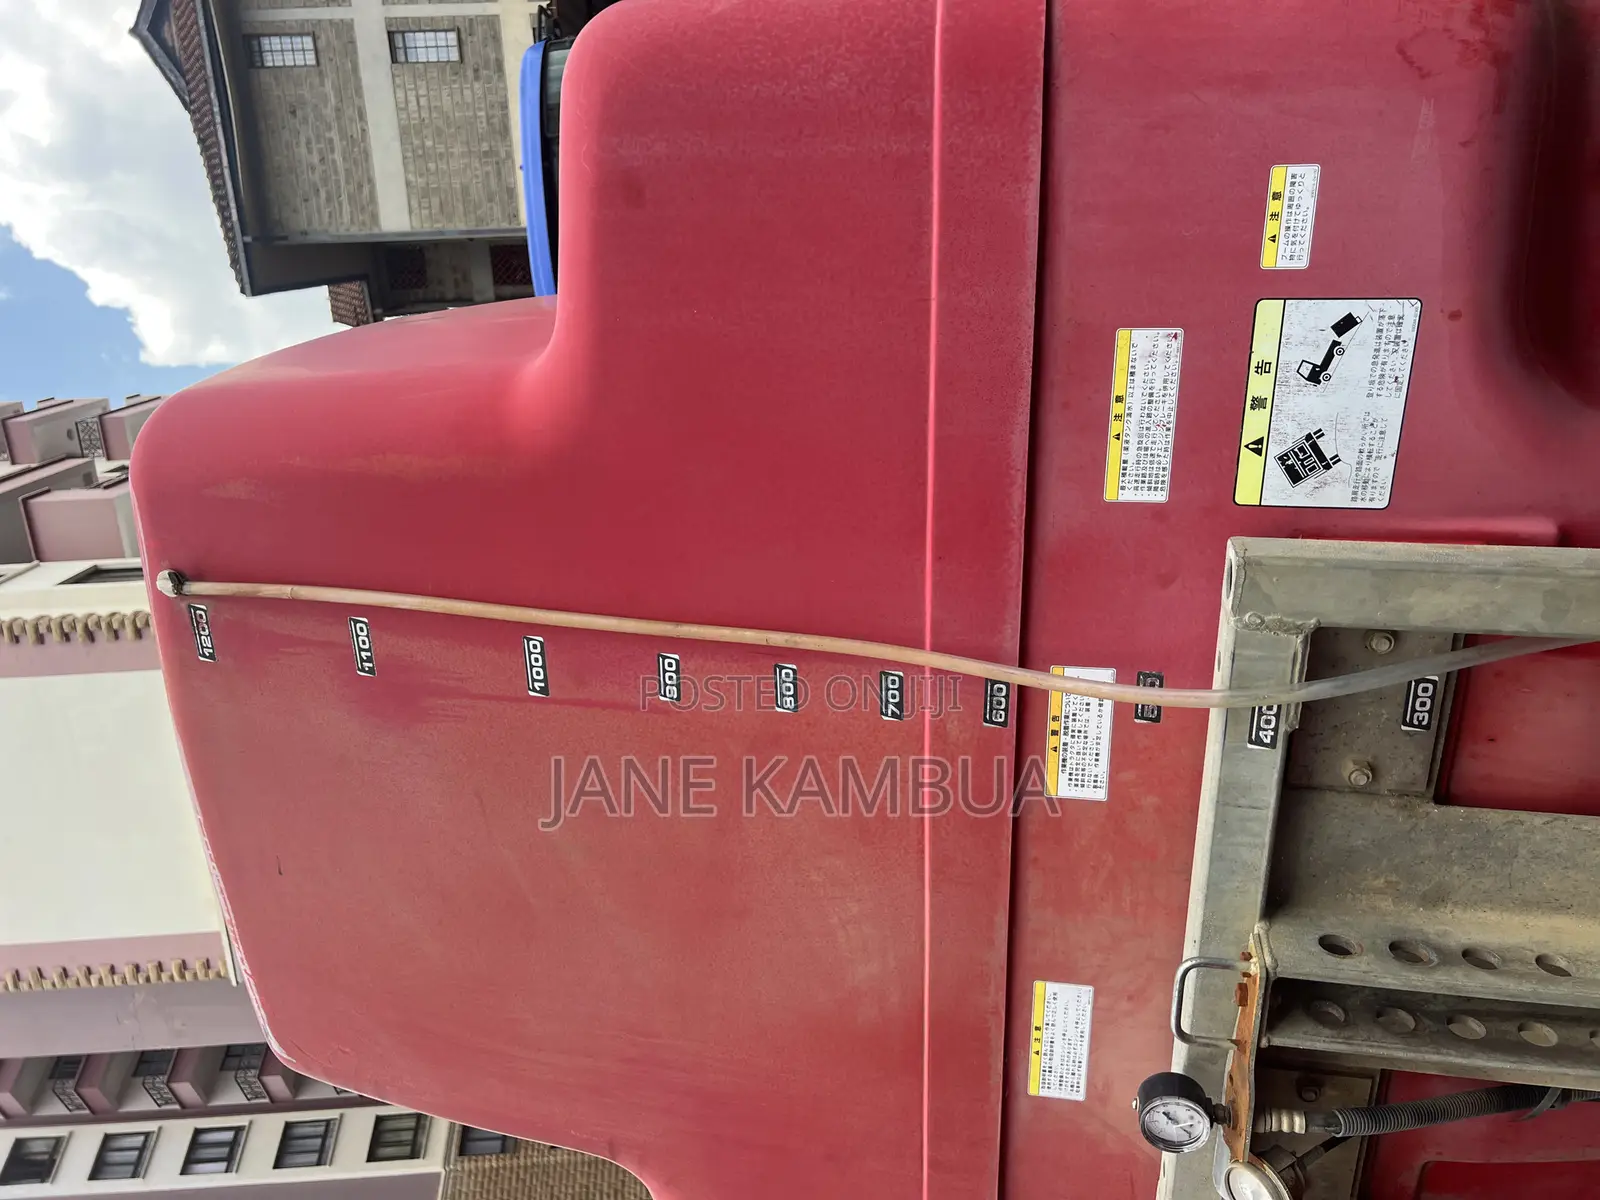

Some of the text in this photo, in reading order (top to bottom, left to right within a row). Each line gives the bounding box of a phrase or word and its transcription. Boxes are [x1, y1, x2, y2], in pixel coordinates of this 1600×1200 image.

[1269, 191, 1282, 221] 注意
[1290, 173, 1305, 261] 物に気を付けてゆっくりと
[1298, 206, 1309, 261] 行ってください。
[1249, 359, 1272, 411] 警告
[1113, 394, 1124, 422] 注意
[356, 623, 373, 670] 1100
[529, 640, 544, 690] 1000
[664, 659, 677, 699] 900
[781, 668, 795, 710] 800
[887, 676, 900, 716] 700
[1143, 677, 1160, 718] 50
[1413, 683, 1433, 725] 300
